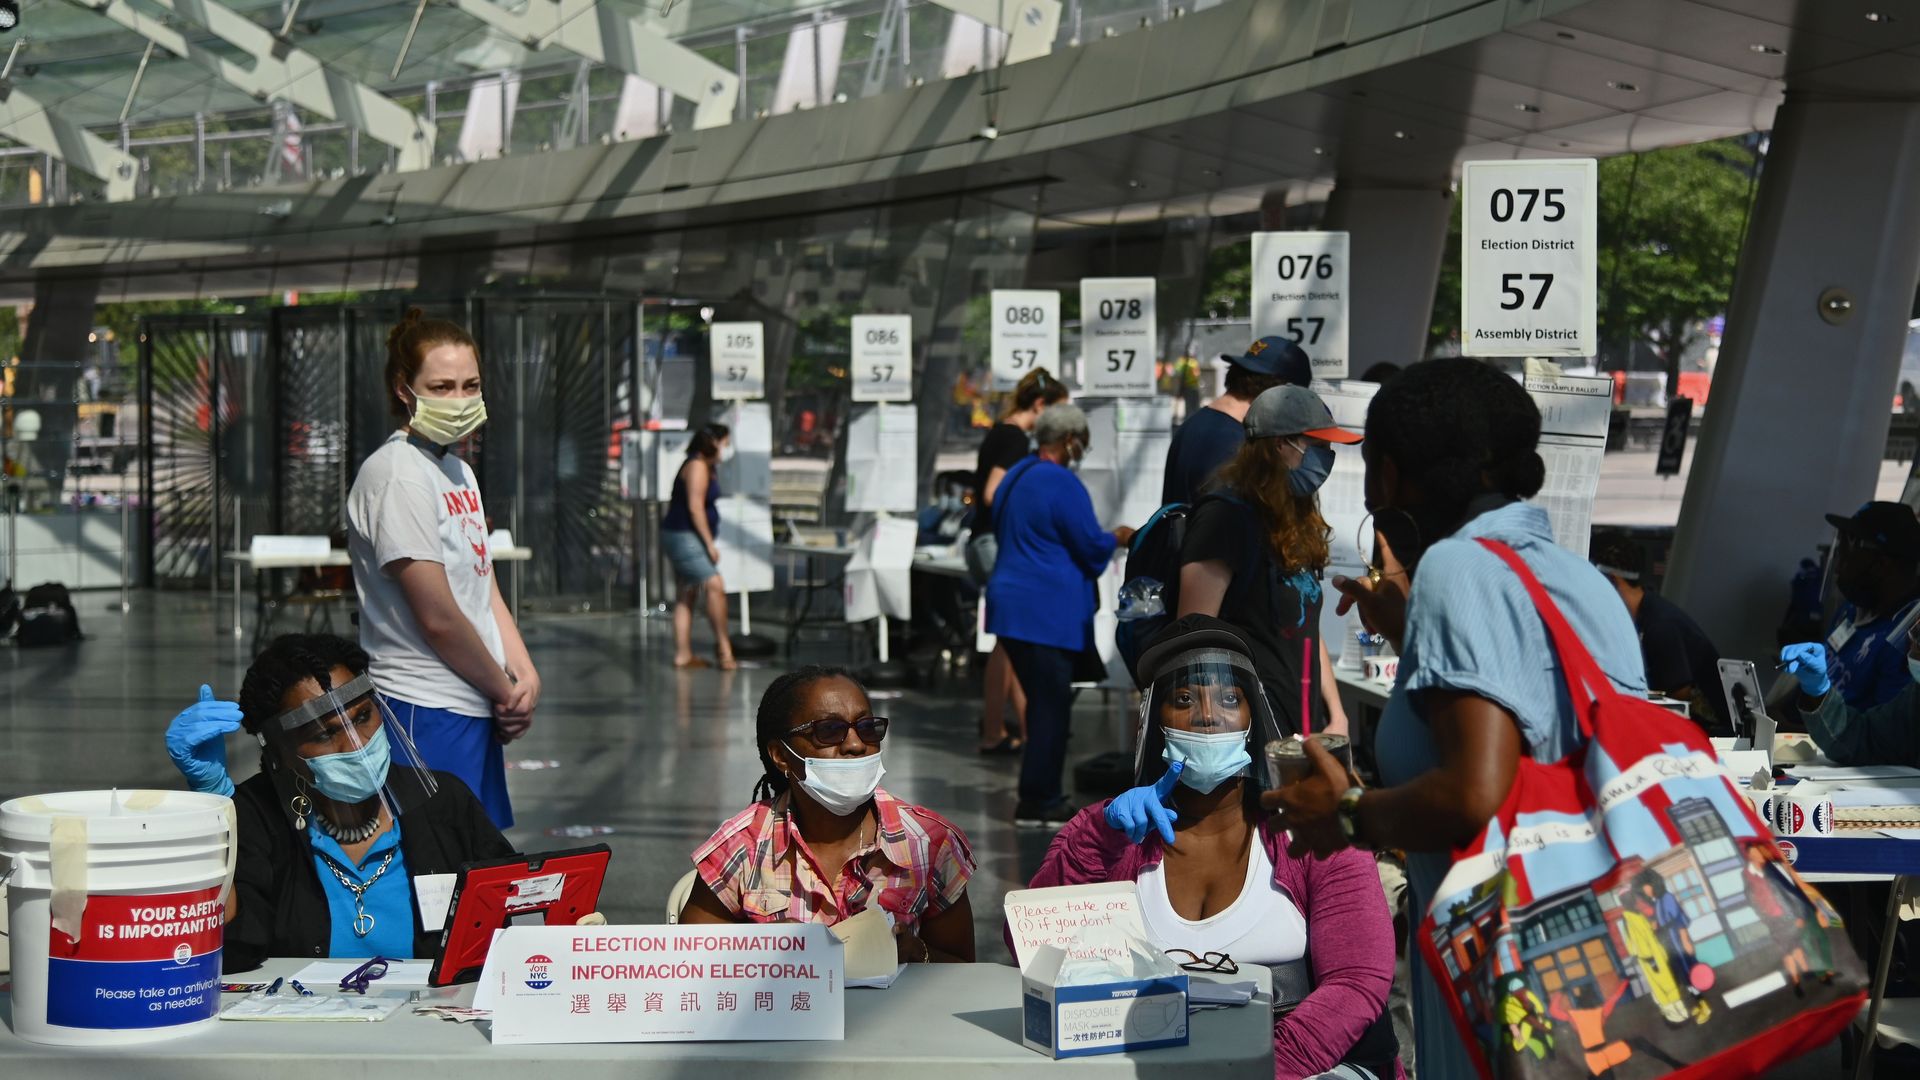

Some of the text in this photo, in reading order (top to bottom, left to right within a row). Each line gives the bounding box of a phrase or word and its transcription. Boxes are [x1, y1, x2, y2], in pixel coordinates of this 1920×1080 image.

[1490, 188, 1566, 223] 075
[1481, 239, 1575, 250] Election District
[1277, 254, 1334, 280] 076
[1271, 292, 1340, 301] Election District
[1500, 273, 1554, 311] 57
[1005, 306, 1044, 325] 080
[1099, 299, 1142, 320] 078
[865, 329, 899, 345] 086
[1287, 317, 1325, 345] 57
[1475, 328, 1578, 342] Assembly District
[726, 334, 754, 349] 105
[1011, 349, 1038, 369] 57
[1106, 350, 1136, 373] 57
[1311, 358, 1343, 367] District
[727, 365, 749, 382] 57
[870, 365, 895, 383] 57
[1551, 384, 1575, 392] SAMPLE
[1575, 385, 1599, 393] BALLOT
[130, 899, 217, 923] YOUR SAFETY
[1011, 900, 1130, 919] Please take one
[98, 924, 115, 939] IS
[119, 918, 205, 939] IMPORTANT
[206, 915, 218, 930] TO
[1017, 919, 1034, 933] (1)
[1038, 917, 1052, 932] if
[1055, 918, 1077, 934] you
[571, 935, 806, 953] ELECTION INFORMATION
[1022, 934, 1079, 949] have one
[529, 964, 548, 972] VOTE
[530, 972, 548, 980] NYC
[571, 960, 820, 981] INFORMACIÓN ELECTORAL
[95, 987, 136, 999] Please
[139, 986, 166, 998] take
[168, 986, 182, 996] an
[184, 977, 213, 994] antiviral
[148, 994, 205, 1012] as needed.
[570, 991, 812, 1015] 選舉資訊詢問處
[1063, 1006, 1120, 1020] DISPOSABLE
[1064, 1021, 1090, 1032] MASK
[1064, 1029, 1123, 1042] 一次性防护口罩
